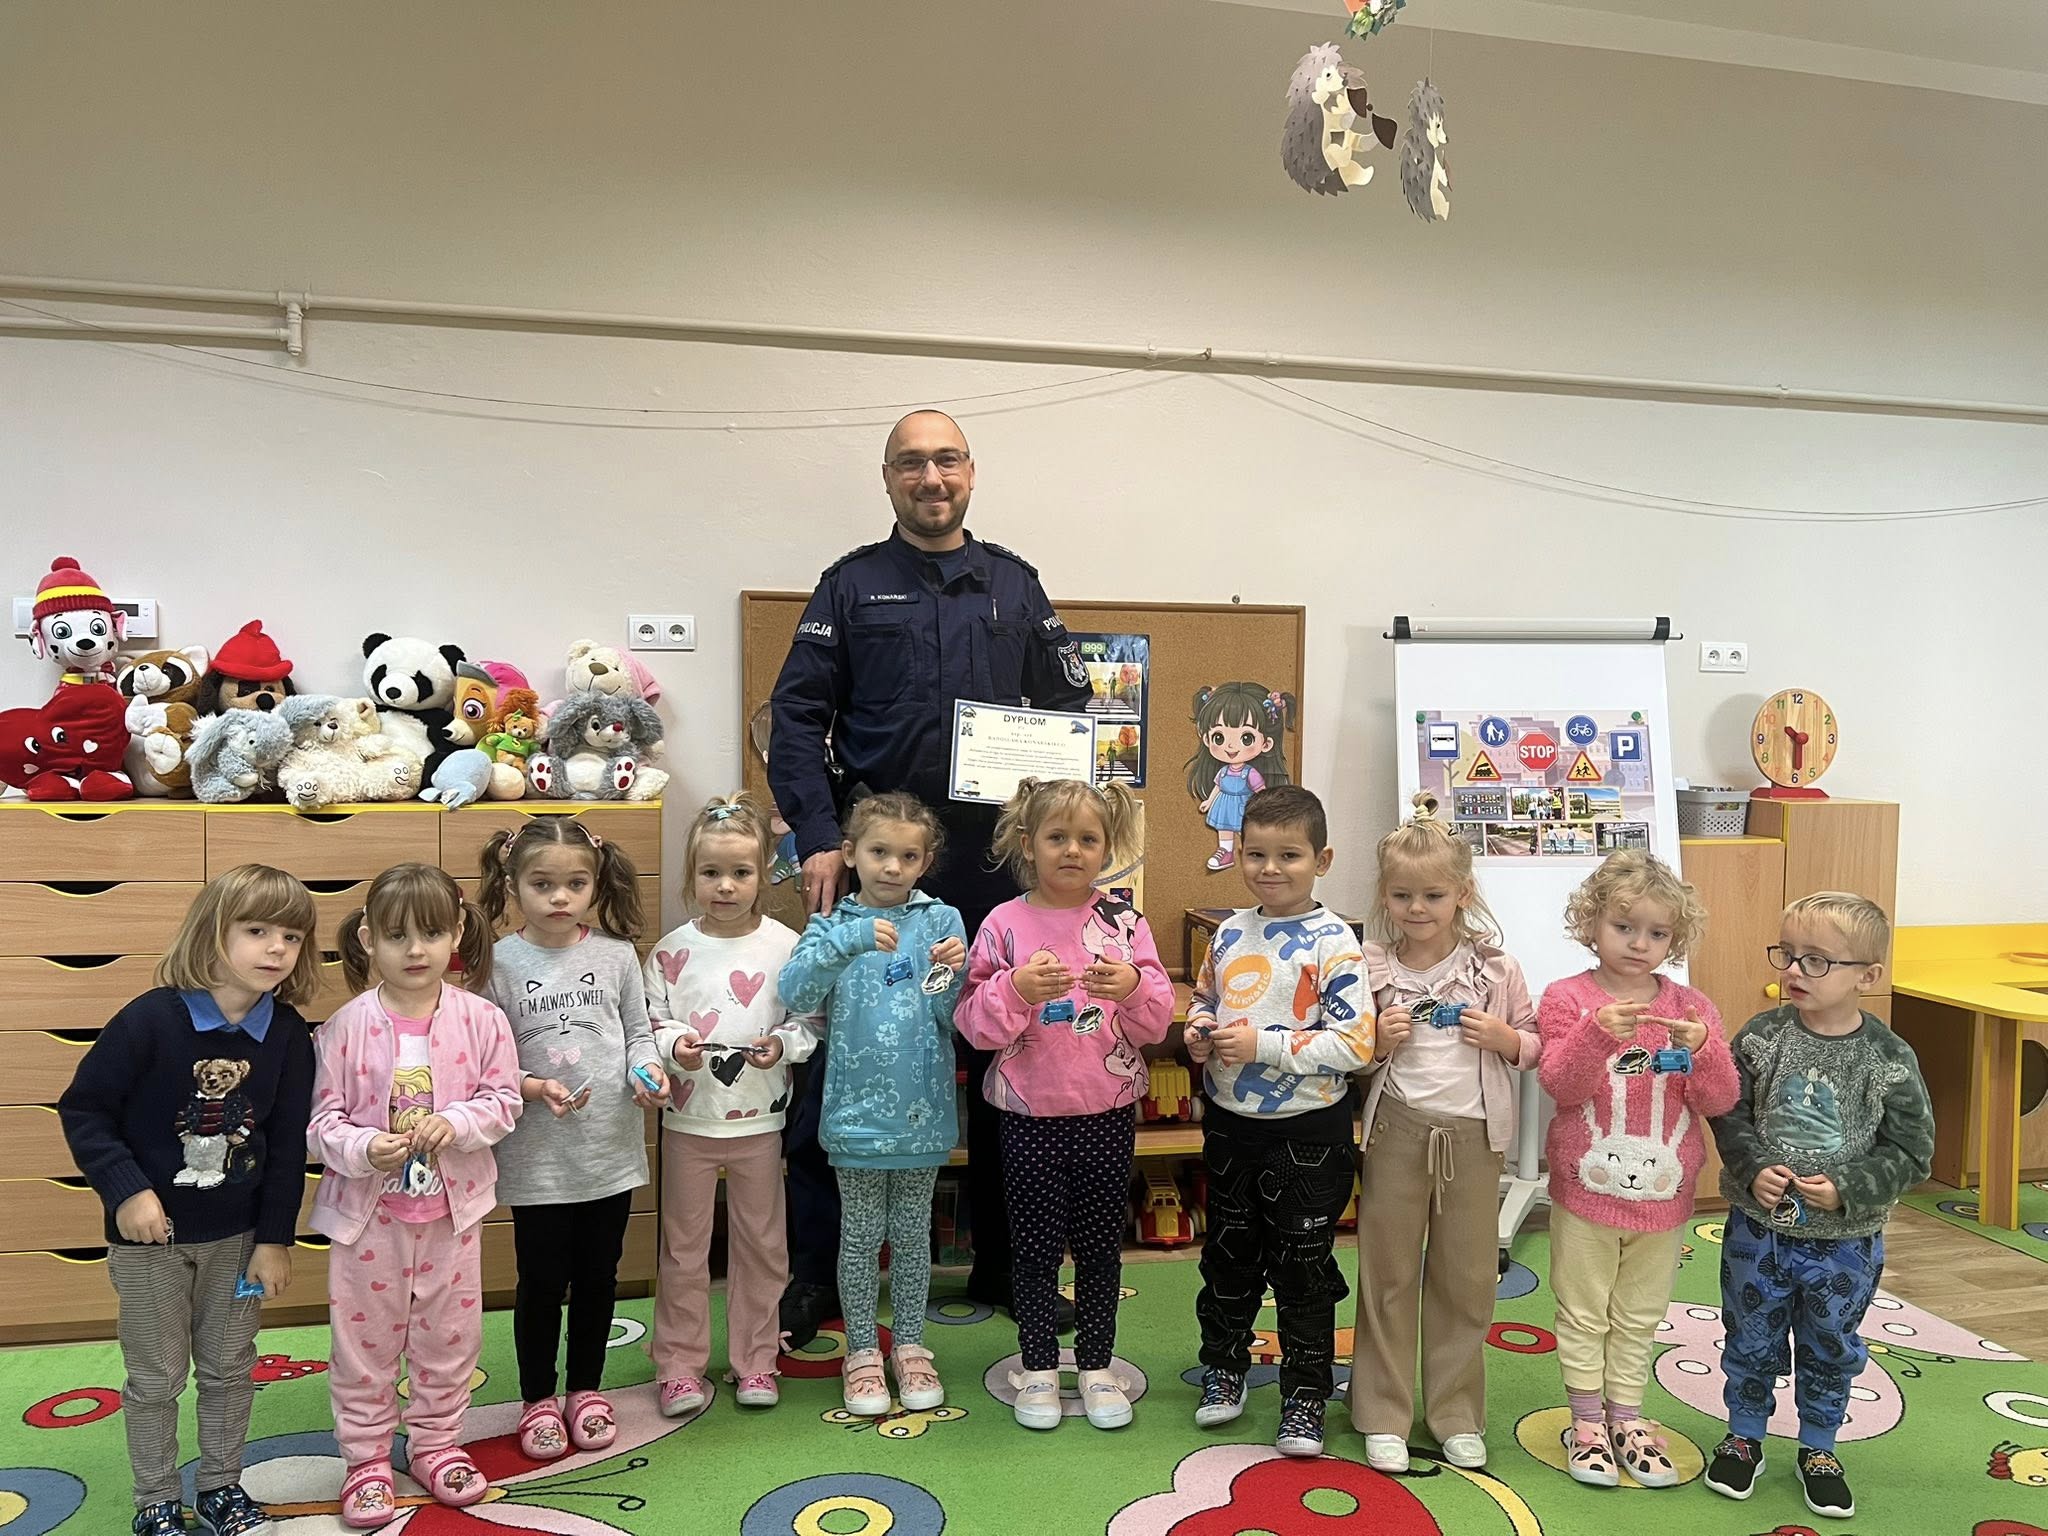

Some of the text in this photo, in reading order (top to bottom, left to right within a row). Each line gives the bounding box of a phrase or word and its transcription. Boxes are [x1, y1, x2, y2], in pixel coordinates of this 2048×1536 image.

[797, 621, 833, 638] POLICJA
[1083, 642, 1104, 654] 999
[1776, 699, 1785, 710] 11
[1792, 693, 1804, 705] 12
[1003, 714, 1047, 726] DYPLOM
[1764, 713, 1776, 725] 10
[1824, 713, 1832, 725] 2
[1757, 733, 1765, 745] 9
[1827, 733, 1835, 744] 3
[1519, 745, 1555, 759] STOP
[1616, 735, 1635, 757] P
[1761, 752, 1769, 764] 8
[1791, 773, 1799, 784] 6
[1809, 767, 1817, 778] 5
[1299, 924, 1338, 945] happy
[518, 989, 604, 1017] I'M ALWAYS SWEET
